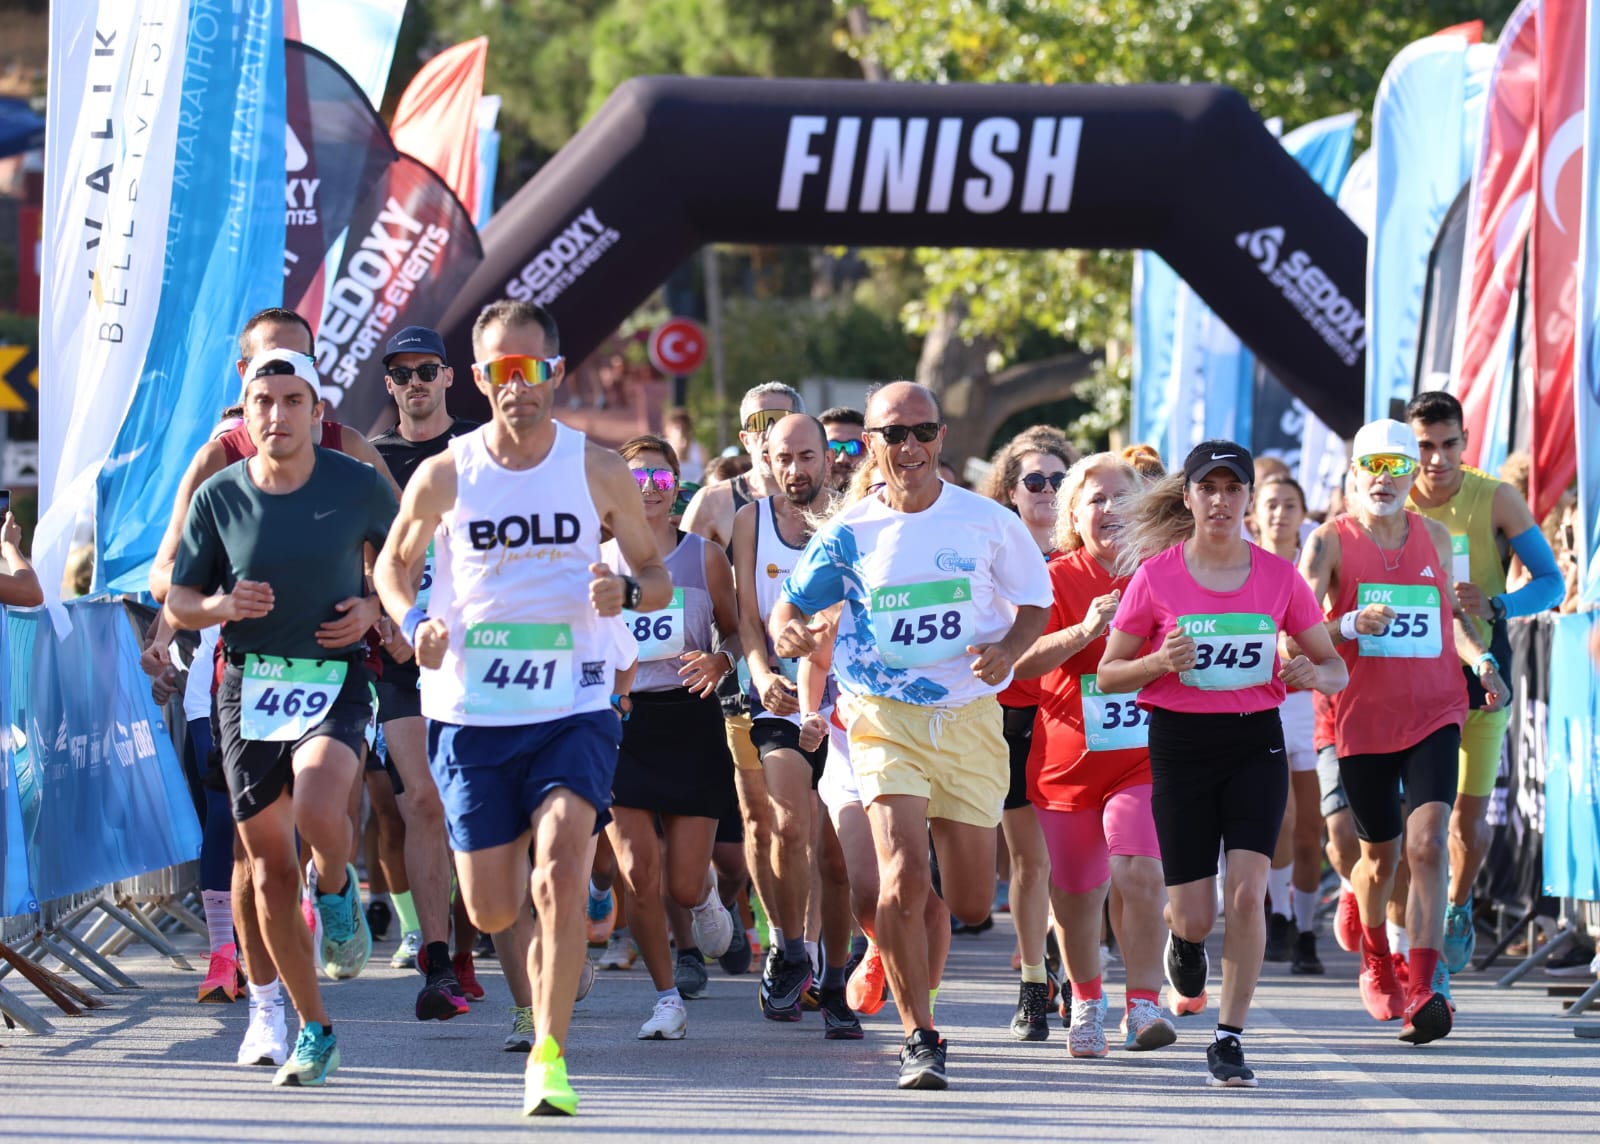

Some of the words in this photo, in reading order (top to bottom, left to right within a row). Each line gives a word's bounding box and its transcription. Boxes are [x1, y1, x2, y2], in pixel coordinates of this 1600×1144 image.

[776, 115, 1084, 213] FINISH
[505, 207, 605, 303] SEDOXY
[318, 196, 424, 376] SEDOXY
[332, 303, 398, 389] SPORTS
[384, 223, 450, 306] EVENTS
[469, 512, 581, 551] BOLD
[877, 591, 911, 609] 10K
[1363, 589, 1393, 603] 10K
[472, 630, 511, 647] 10K
[625, 615, 673, 641] 86
[890, 610, 962, 647] 458
[1184, 618, 1217, 635] 10K
[251, 662, 285, 679] 10K
[1193, 641, 1264, 671] 345
[481, 657, 558, 691] 441
[254, 686, 329, 719] 469
